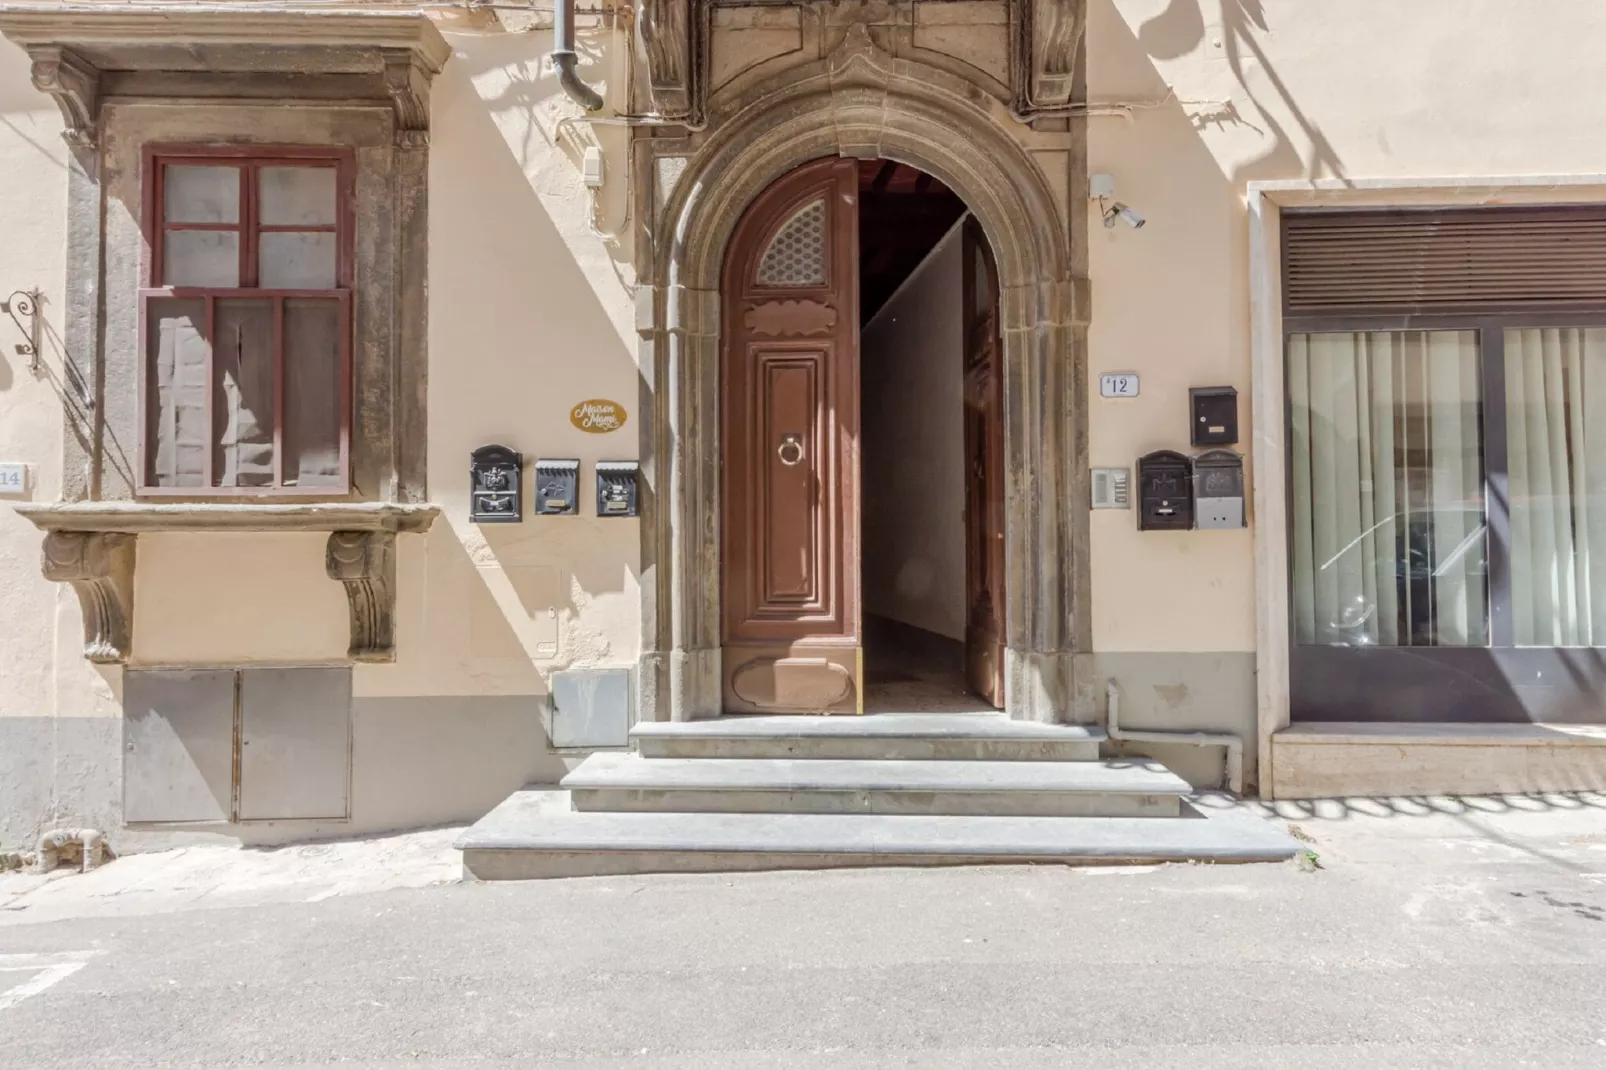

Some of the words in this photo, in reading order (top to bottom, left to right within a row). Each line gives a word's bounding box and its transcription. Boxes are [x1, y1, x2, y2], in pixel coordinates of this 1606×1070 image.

[1112, 378, 1128, 393] 12
[575, 403, 615, 417] Maison
[583, 413, 618, 428] Mami
[0, 471, 20, 485] 14
